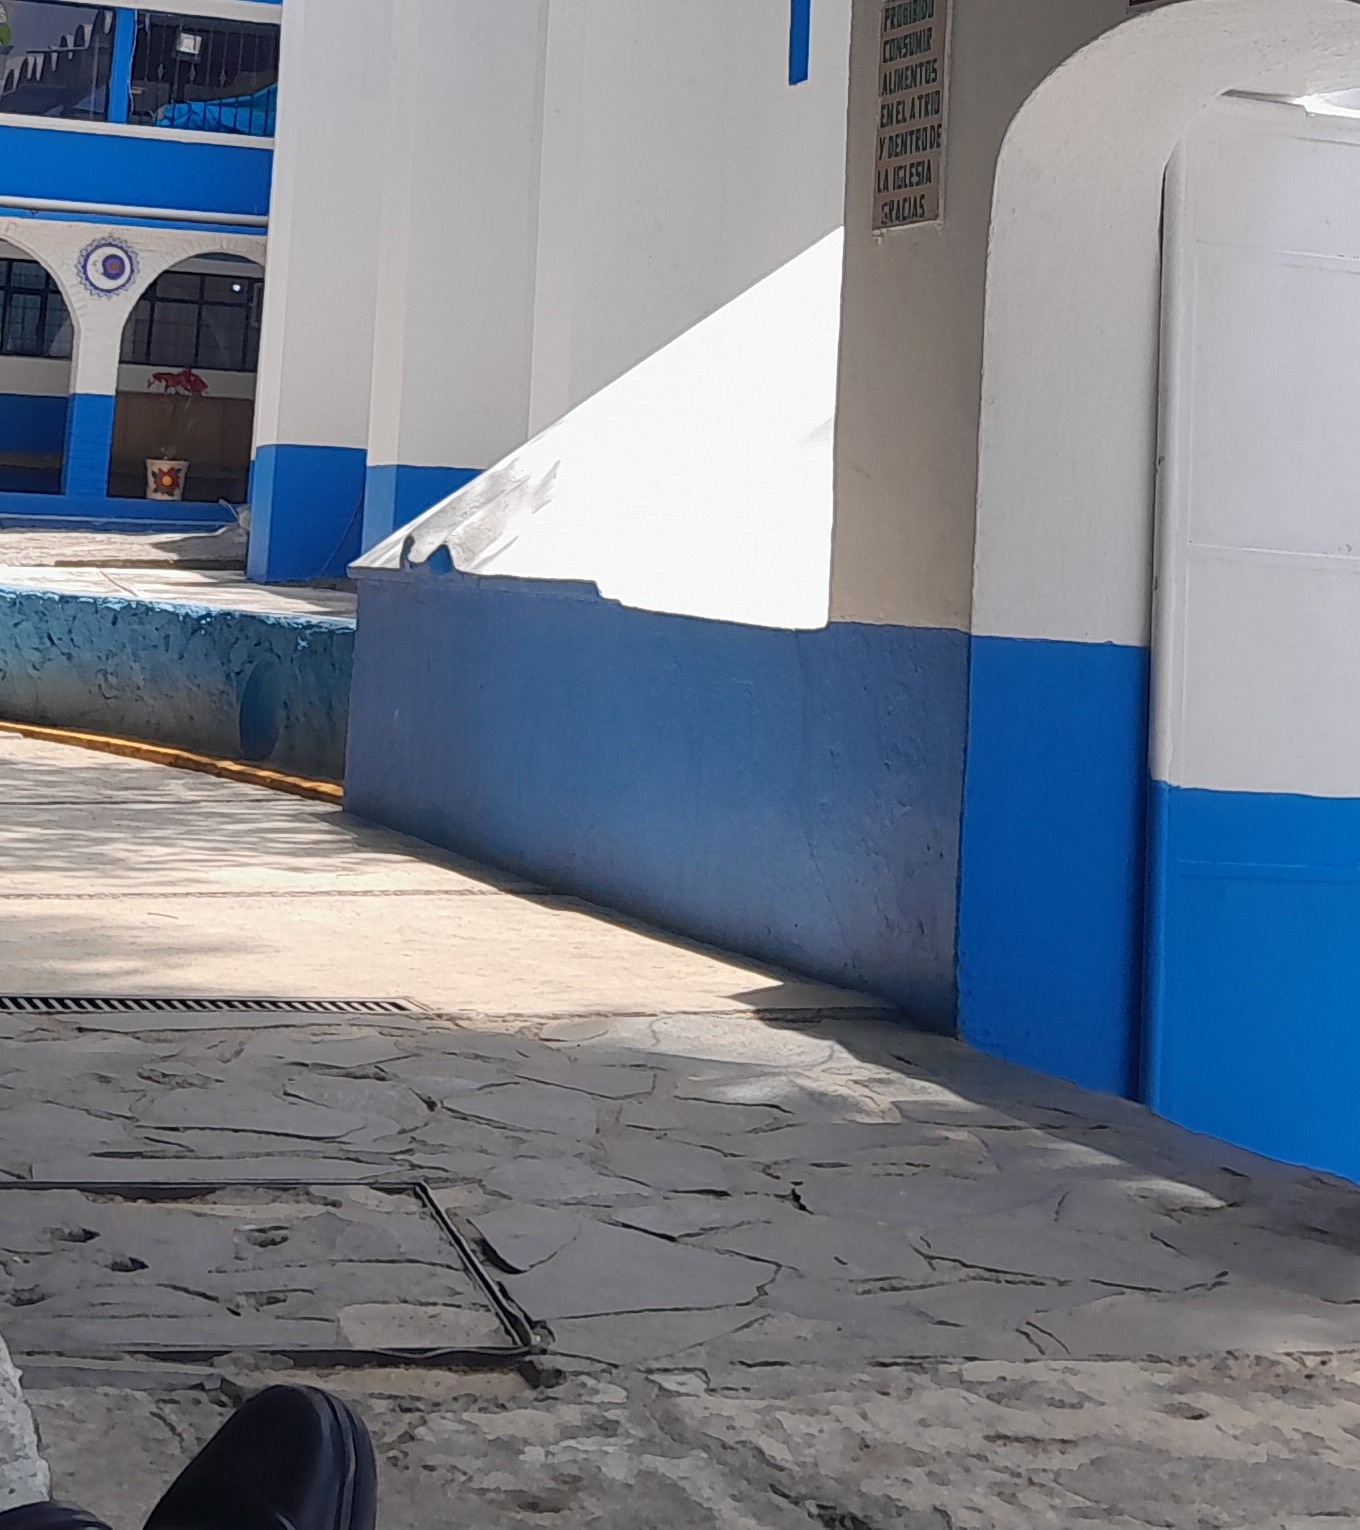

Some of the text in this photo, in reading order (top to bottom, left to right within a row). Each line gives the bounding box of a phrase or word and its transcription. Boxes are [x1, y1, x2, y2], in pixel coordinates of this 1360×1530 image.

[883, 26, 933, 63] CONSUMIR
[881, 57, 938, 96] ALIMENTOS
[880, 89, 940, 129] EN EL ATRIO
[879, 123, 942, 161] Y DENTRO DE
[877, 158, 932, 193] LA IGLESIA
[880, 193, 926, 225] GRACIAS
